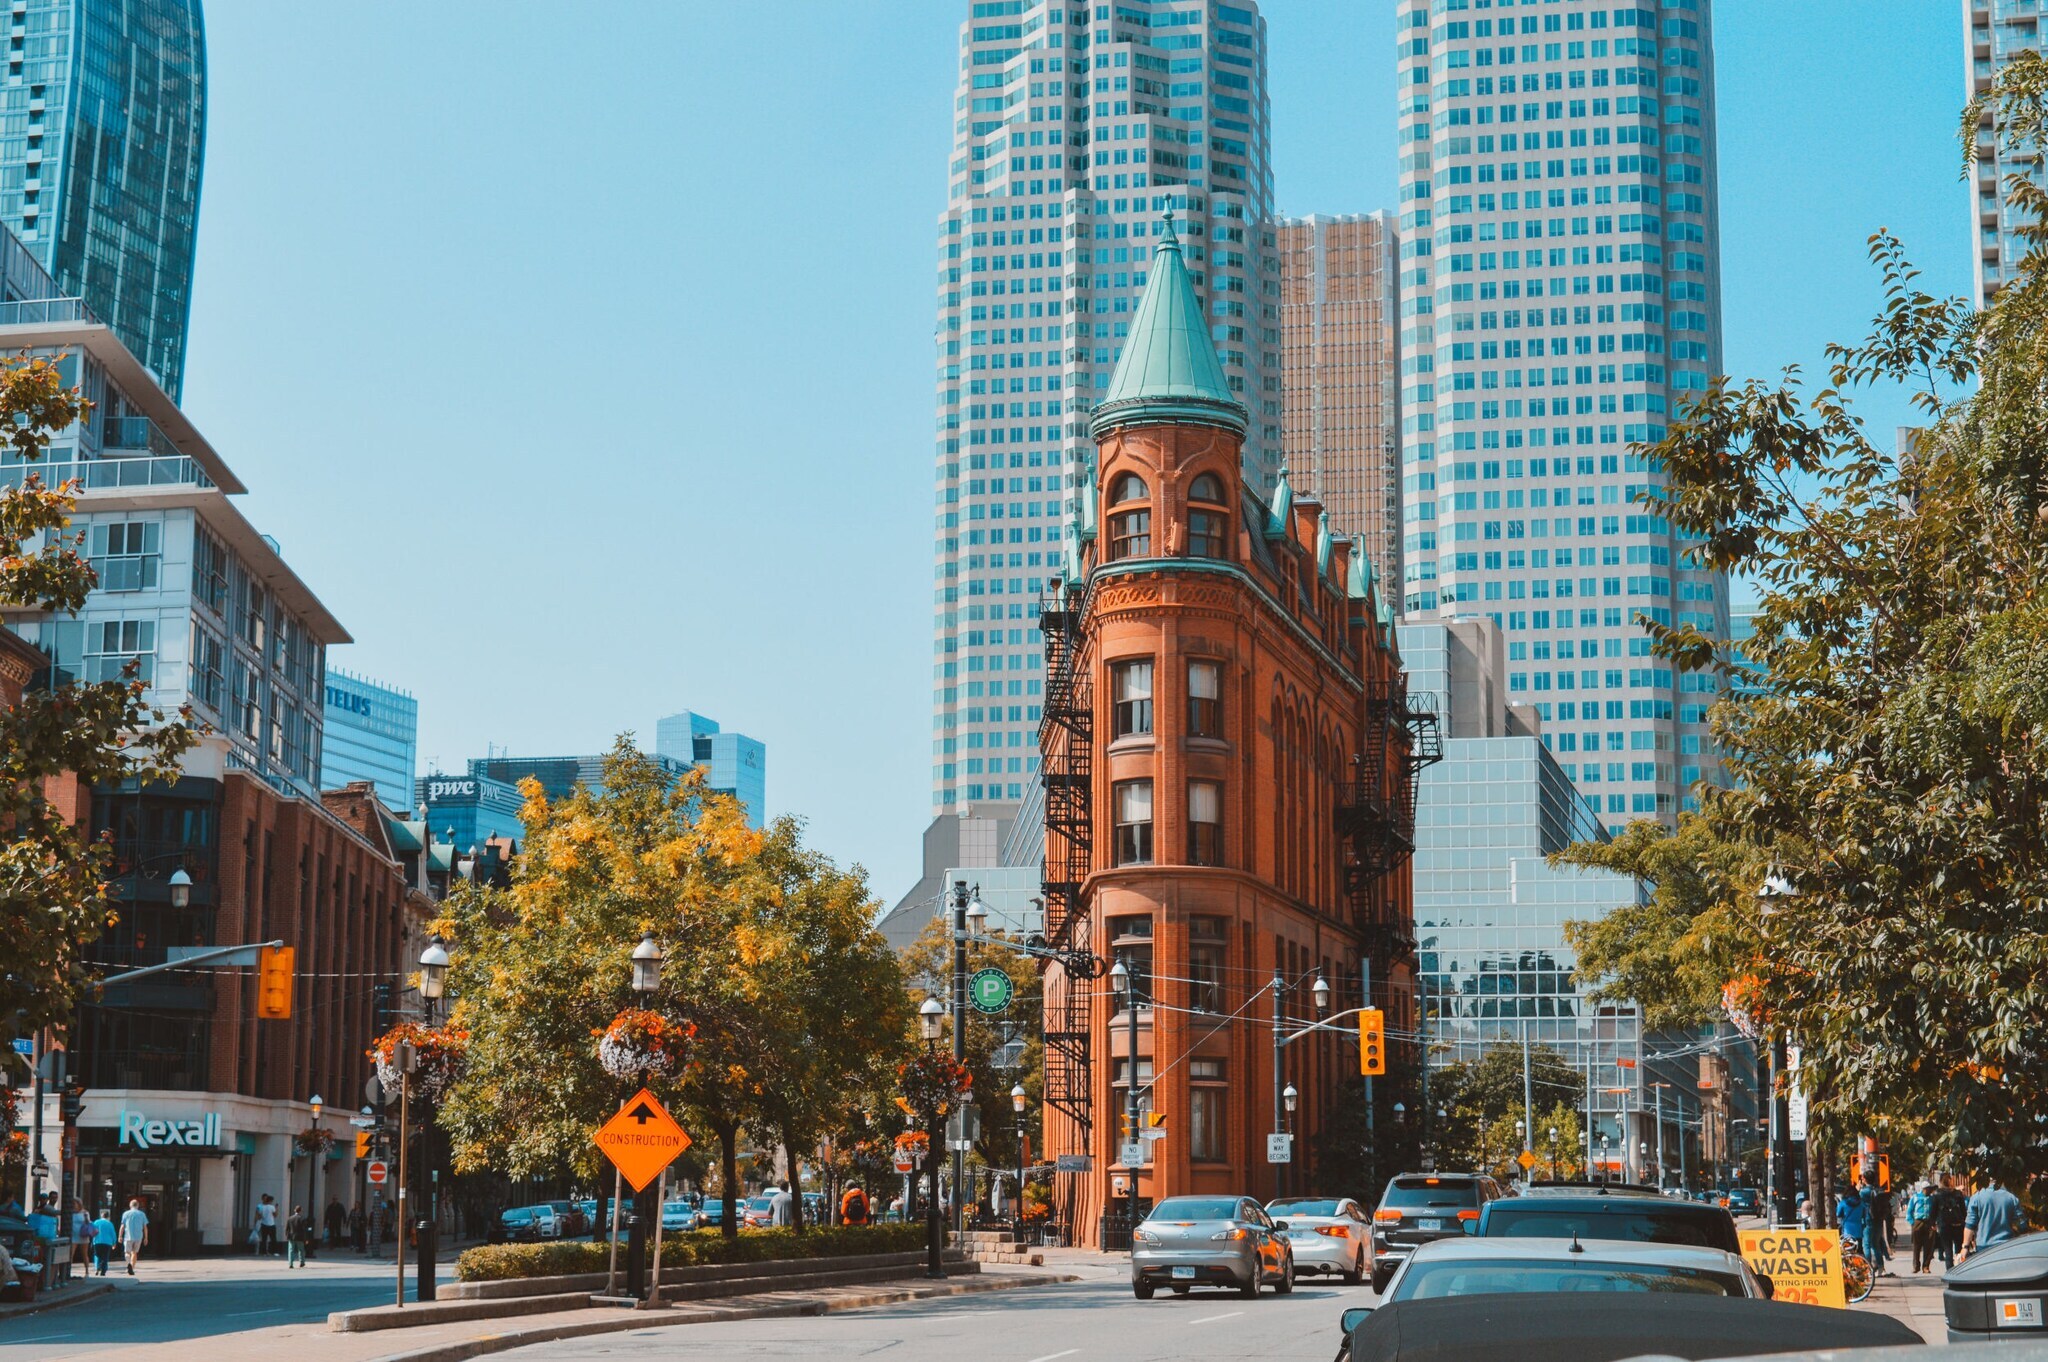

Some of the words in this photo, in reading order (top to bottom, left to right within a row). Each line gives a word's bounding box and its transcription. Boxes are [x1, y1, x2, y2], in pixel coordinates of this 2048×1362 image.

[326, 686, 371, 717] TELUS
[428, 781, 475, 801] pwc
[480, 782, 500, 800] pwc
[970, 969, 1011, 989] MUNICIPAL
[983, 980, 1000, 997] P
[970, 993, 1011, 1012] PARKING
[120, 1109, 221, 1149] Rexall
[603, 1133, 679, 1147] CONSTRUCTION
[1269, 1153, 1289, 1161] BEGINS
[1759, 1237, 1812, 1254] CAR
[1753, 1258, 1828, 1275] WASH
